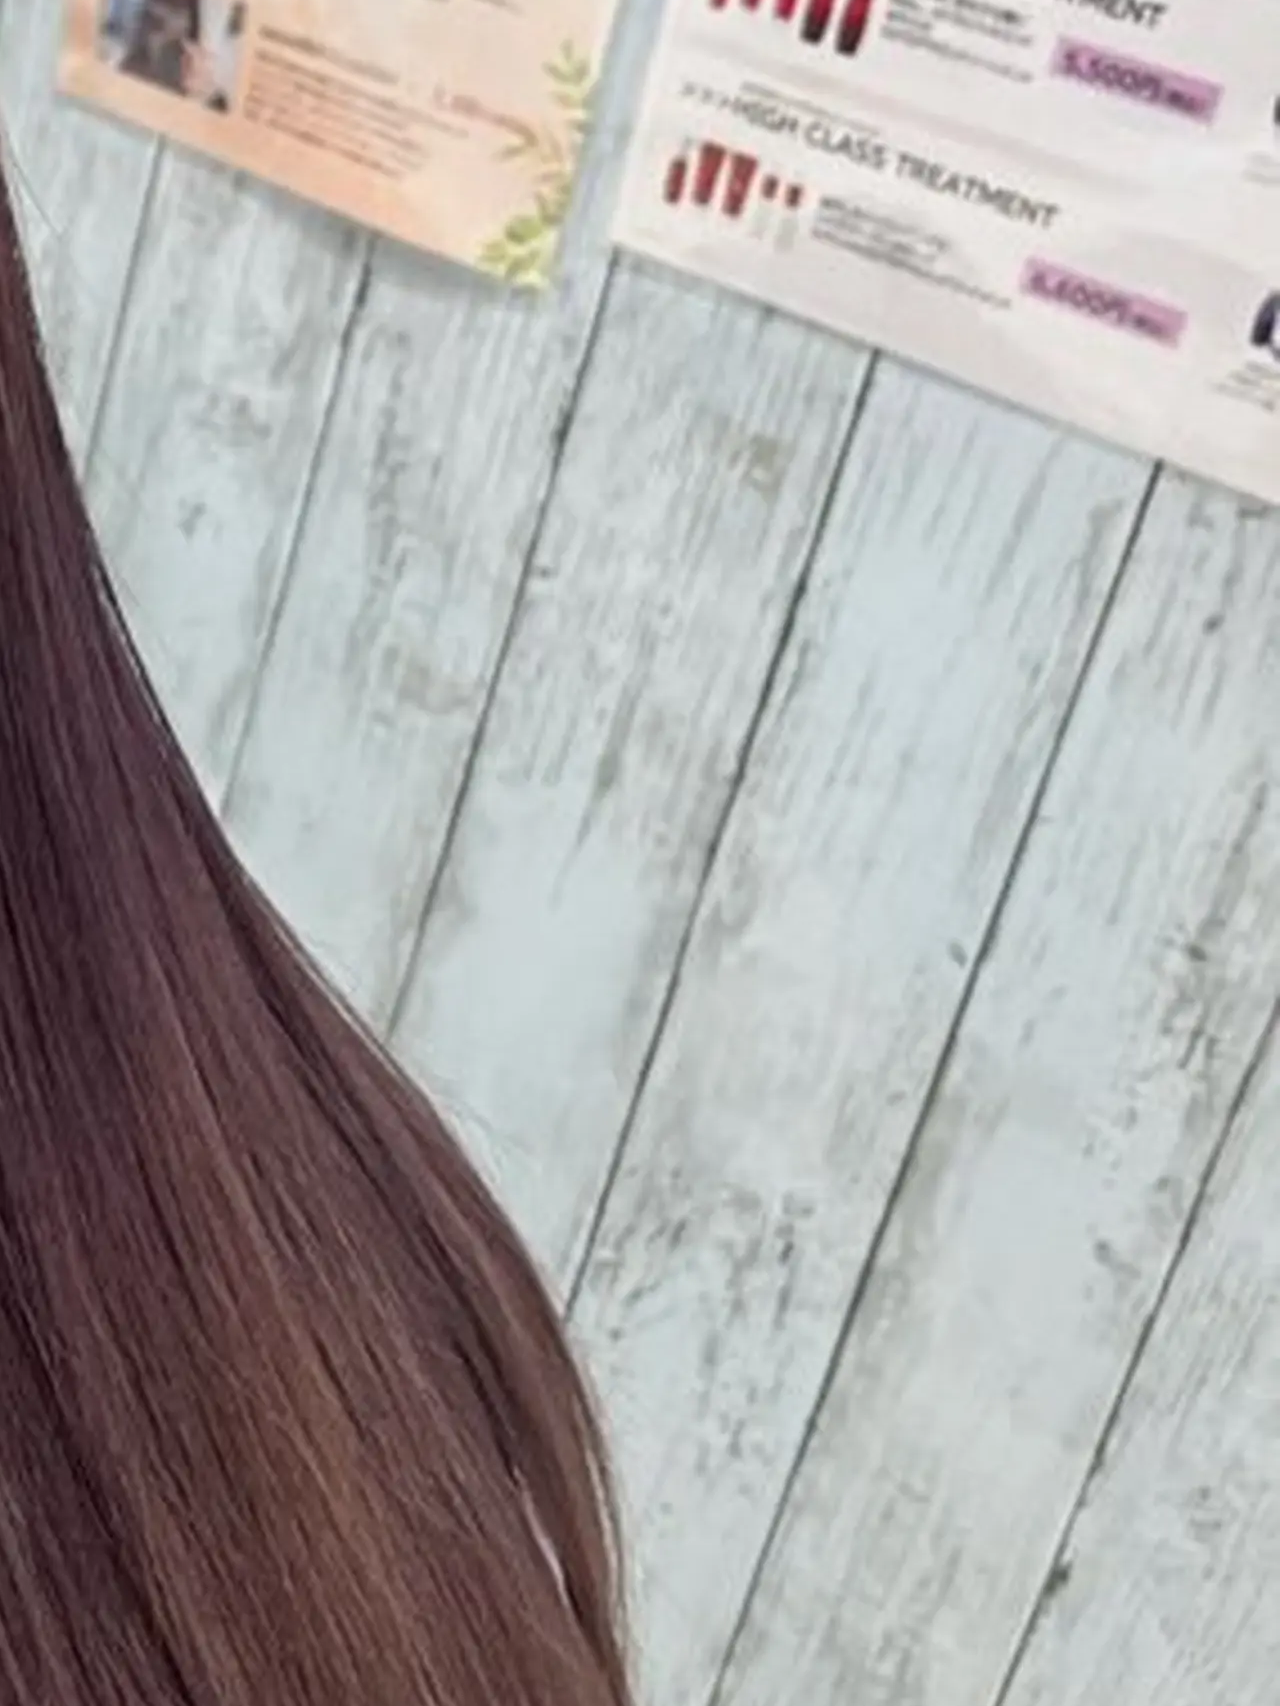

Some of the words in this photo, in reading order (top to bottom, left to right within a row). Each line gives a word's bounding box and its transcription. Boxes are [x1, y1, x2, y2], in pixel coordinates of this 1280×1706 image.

[737, 100, 800, 141] HIGH
[805, 122, 888, 169] CLASS
[897, 153, 1060, 229] TREATMENT
